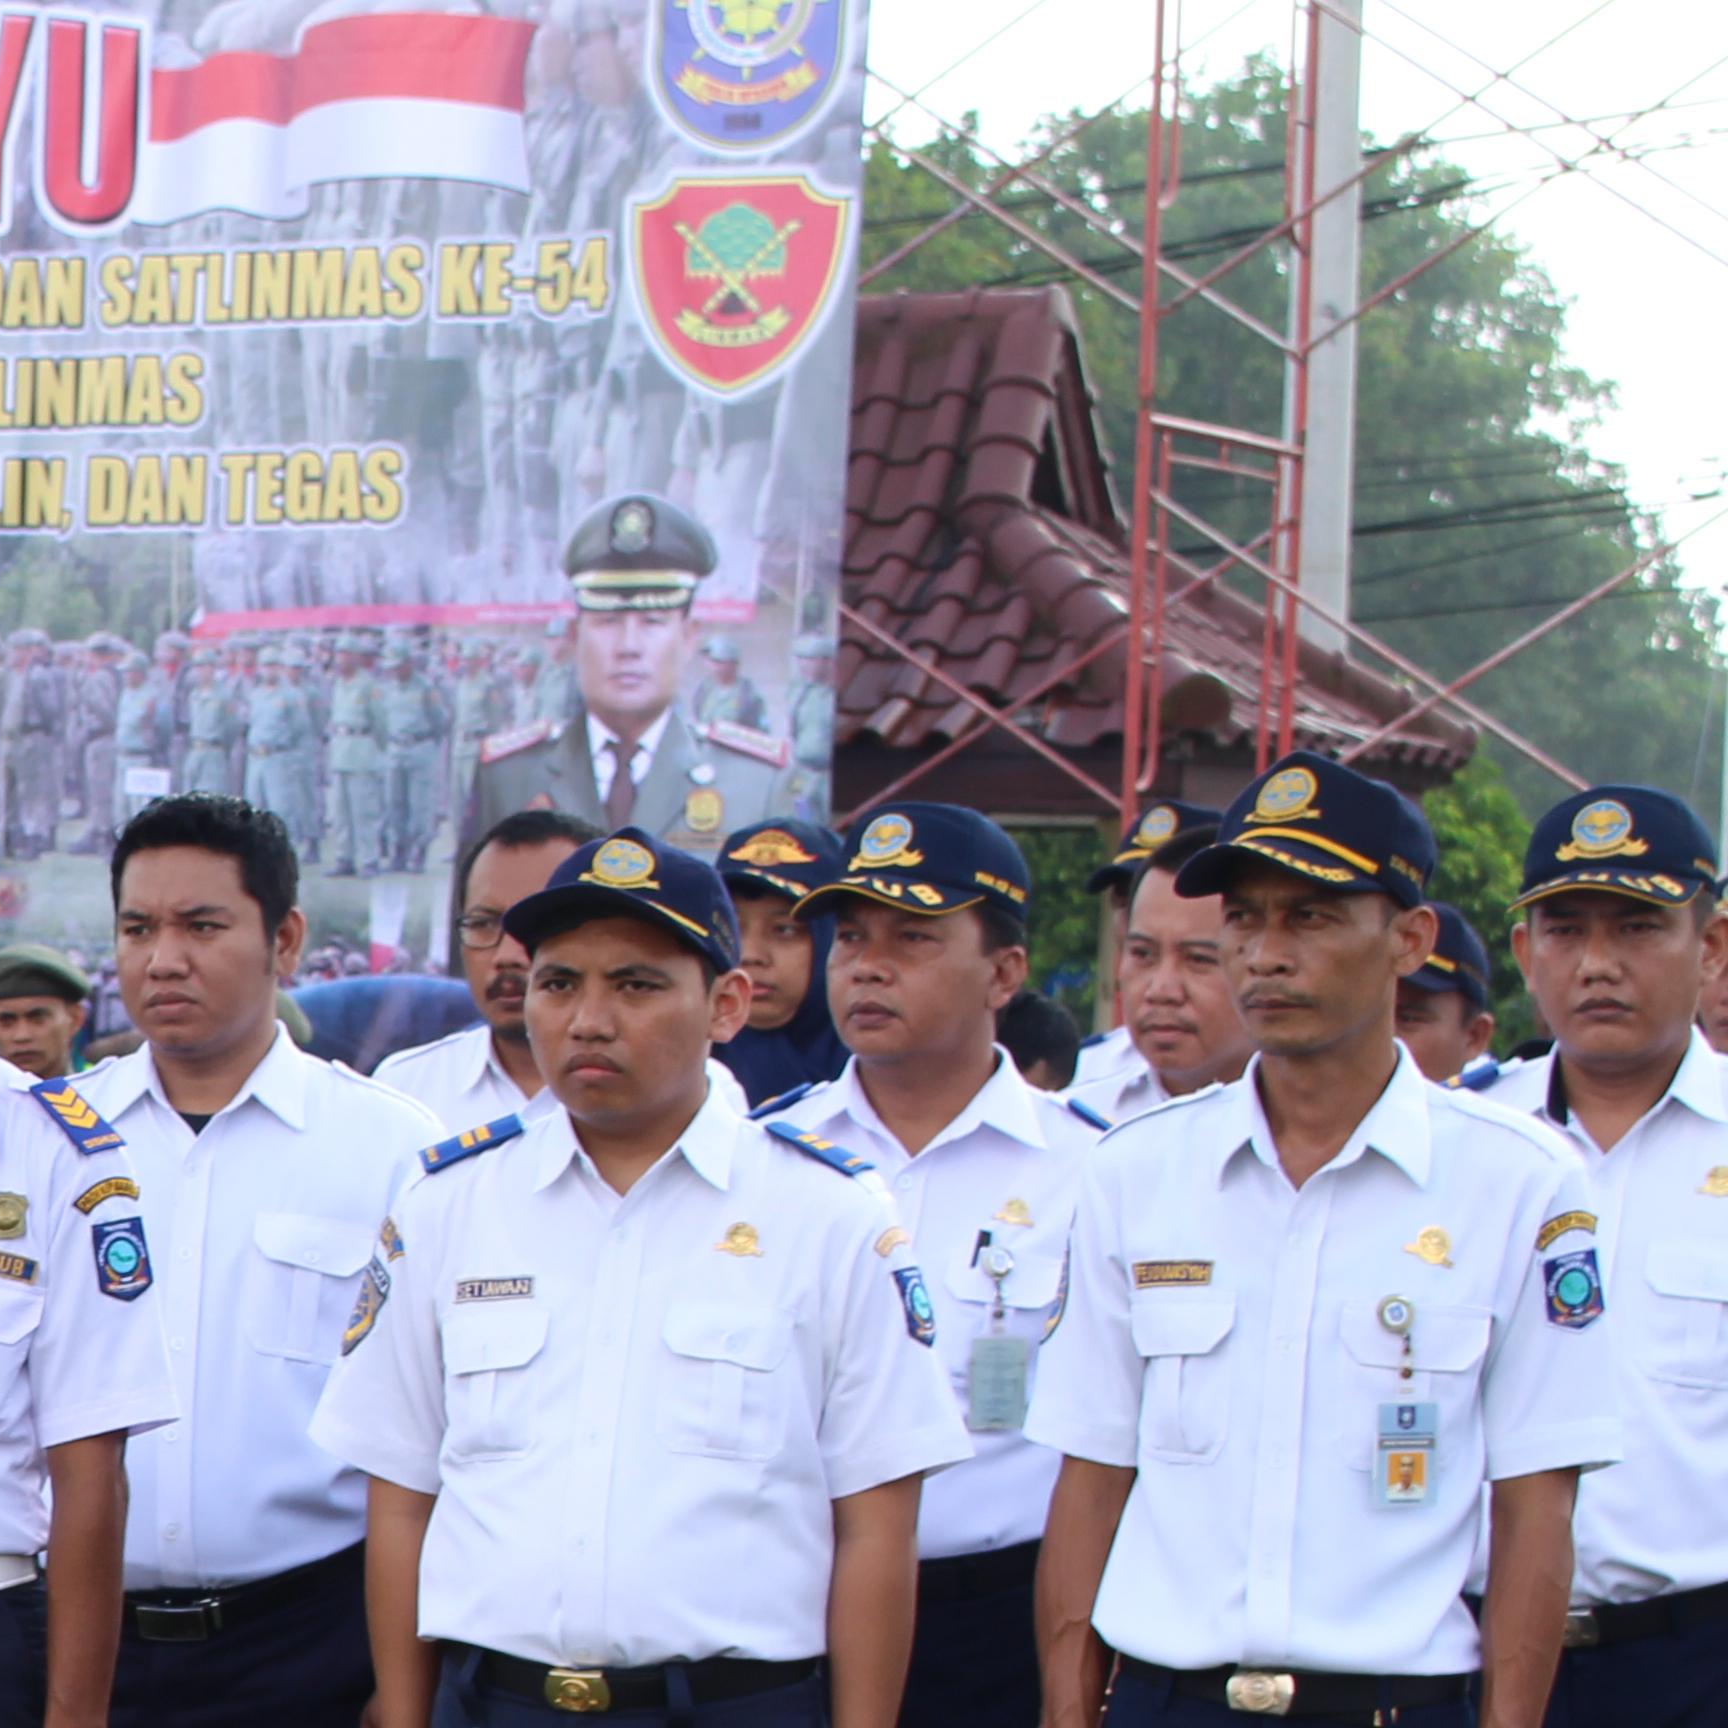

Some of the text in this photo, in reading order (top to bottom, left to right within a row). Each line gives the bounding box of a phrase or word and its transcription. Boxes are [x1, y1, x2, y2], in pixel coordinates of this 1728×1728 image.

[102, 246, 422, 324] SATLINMAS
[440, 239, 608, 313] KE-54
[88, 456, 205, 524] DAN
[223, 450, 401, 522] TEGAS
